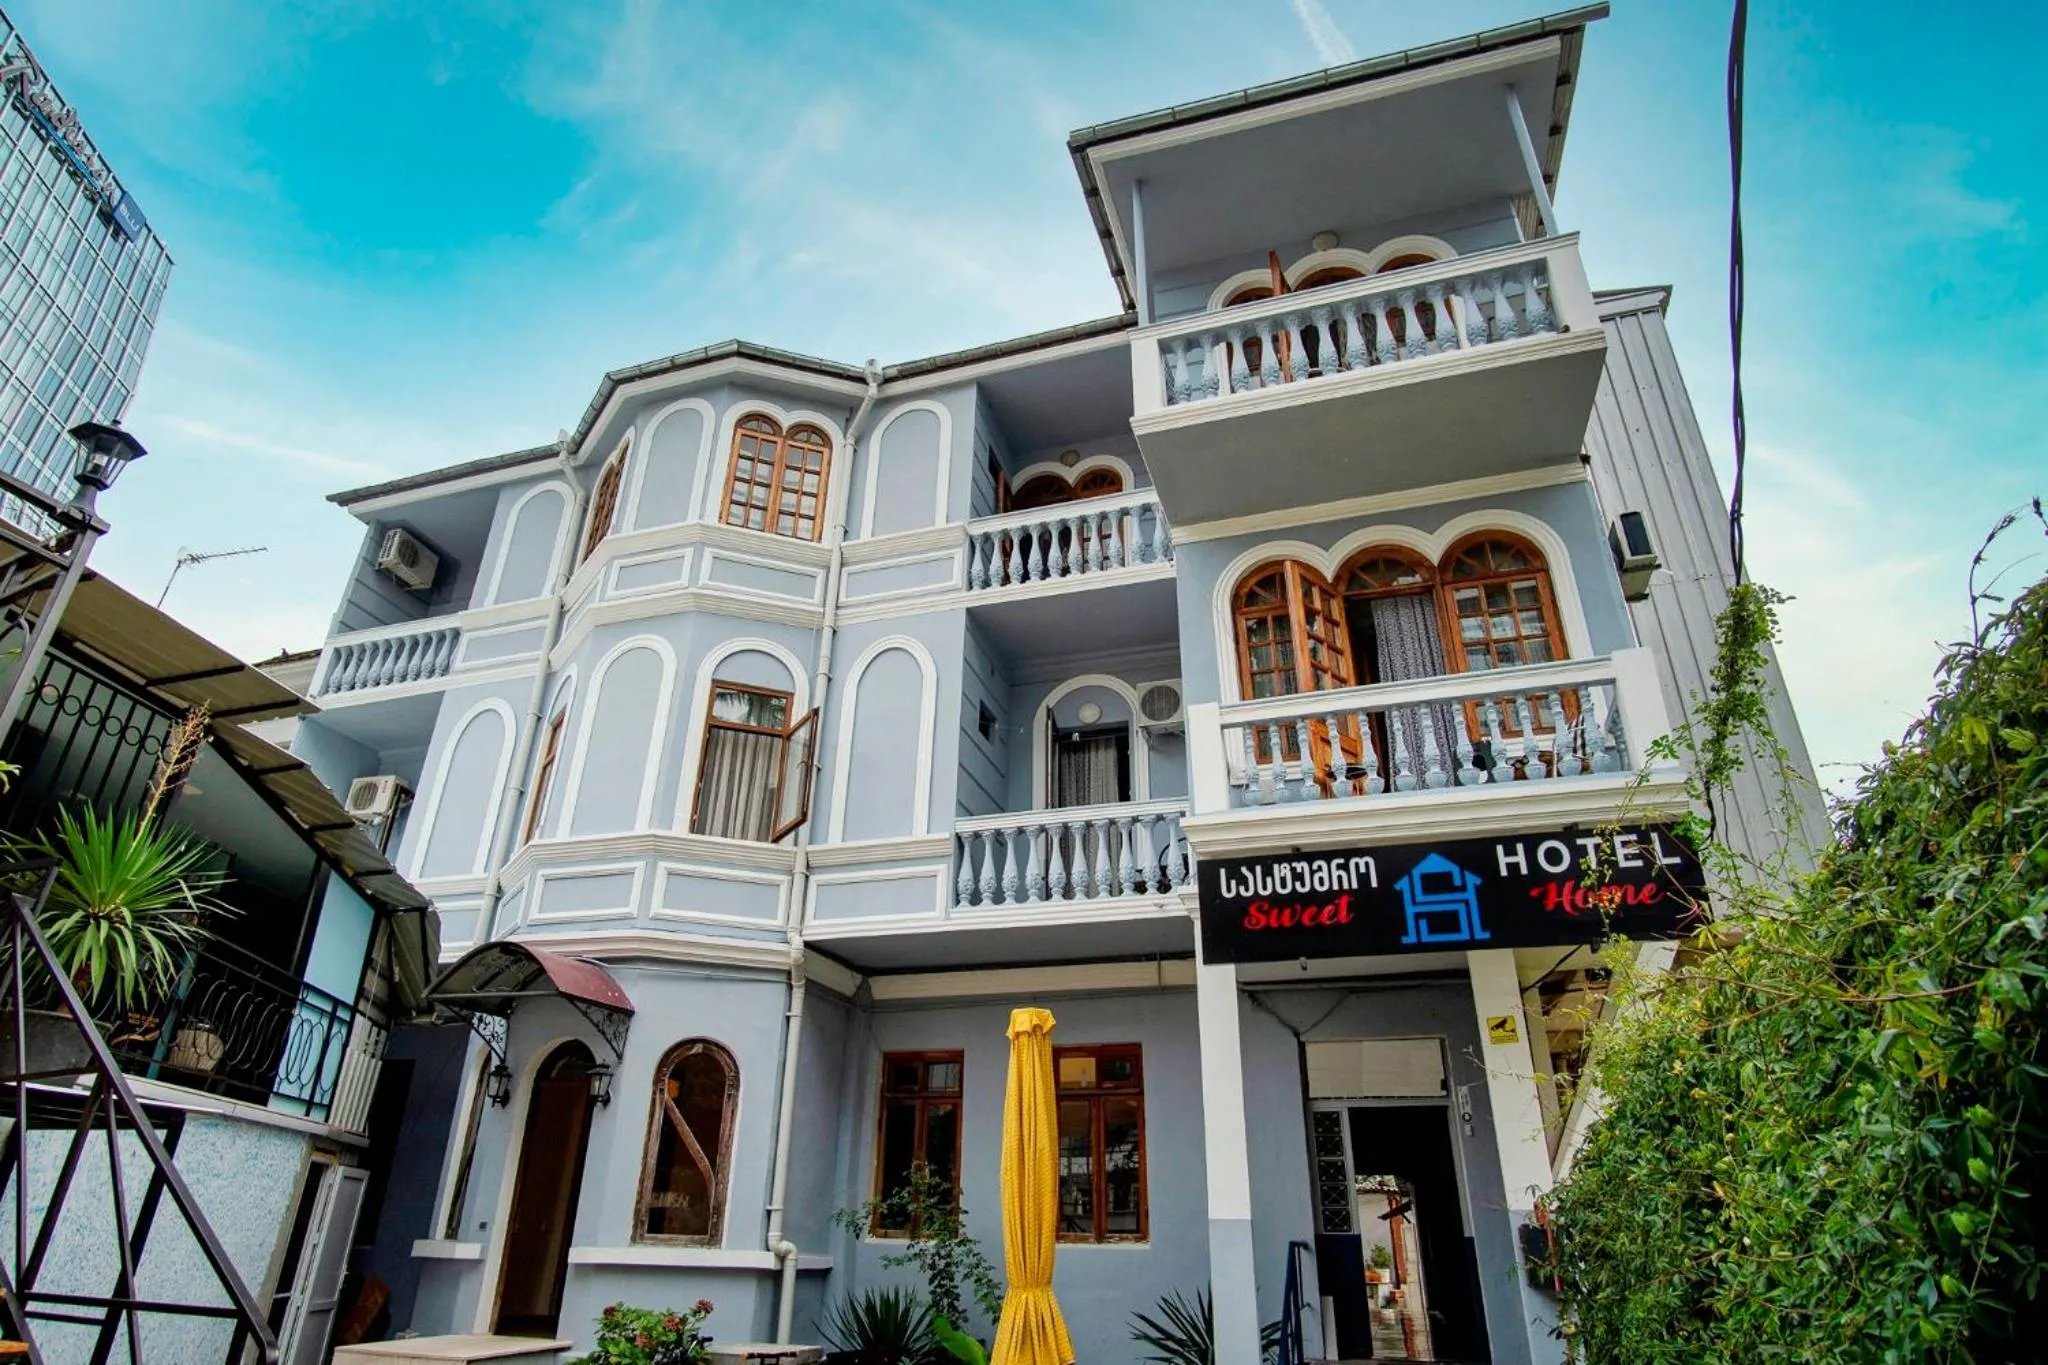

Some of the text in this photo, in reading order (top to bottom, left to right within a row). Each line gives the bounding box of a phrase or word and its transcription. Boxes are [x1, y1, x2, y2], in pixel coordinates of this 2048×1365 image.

[1496, 832, 1682, 877] HOTEL
[1219, 855, 1379, 899] სასტუმრო
[1244, 893, 1355, 930] Sweet
